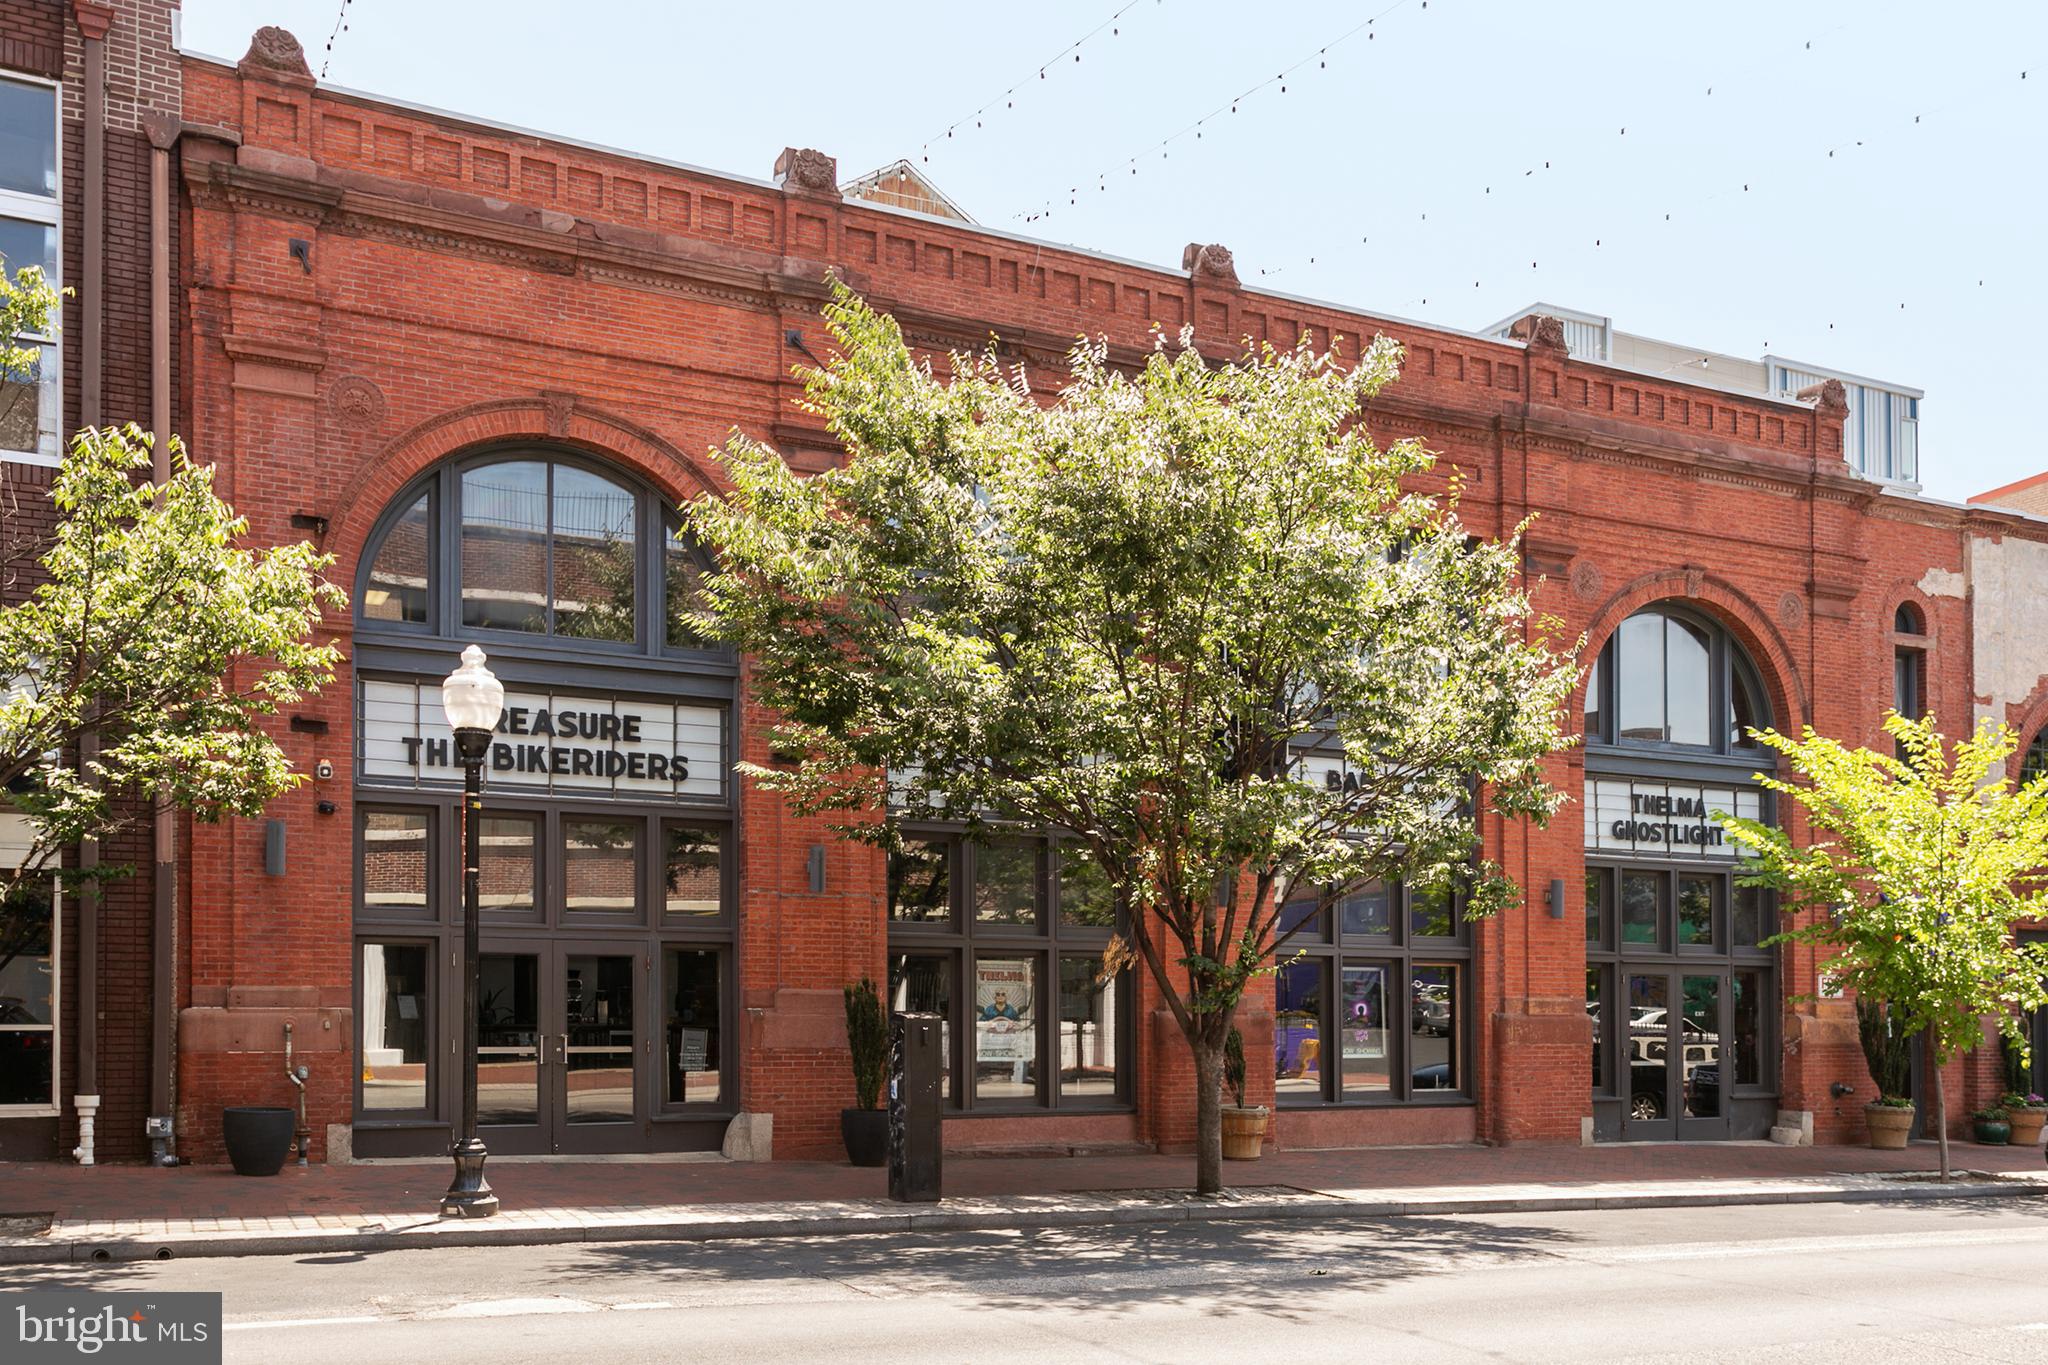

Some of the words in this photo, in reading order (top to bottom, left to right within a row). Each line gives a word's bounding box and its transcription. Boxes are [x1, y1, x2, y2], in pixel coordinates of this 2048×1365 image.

[492, 707, 642, 742] REASURE
[493, 742, 689, 782] BIKERIDERS
[1632, 794, 1707, 818] THELMA
[1612, 820, 1725, 846] GHOSTLIGHT
